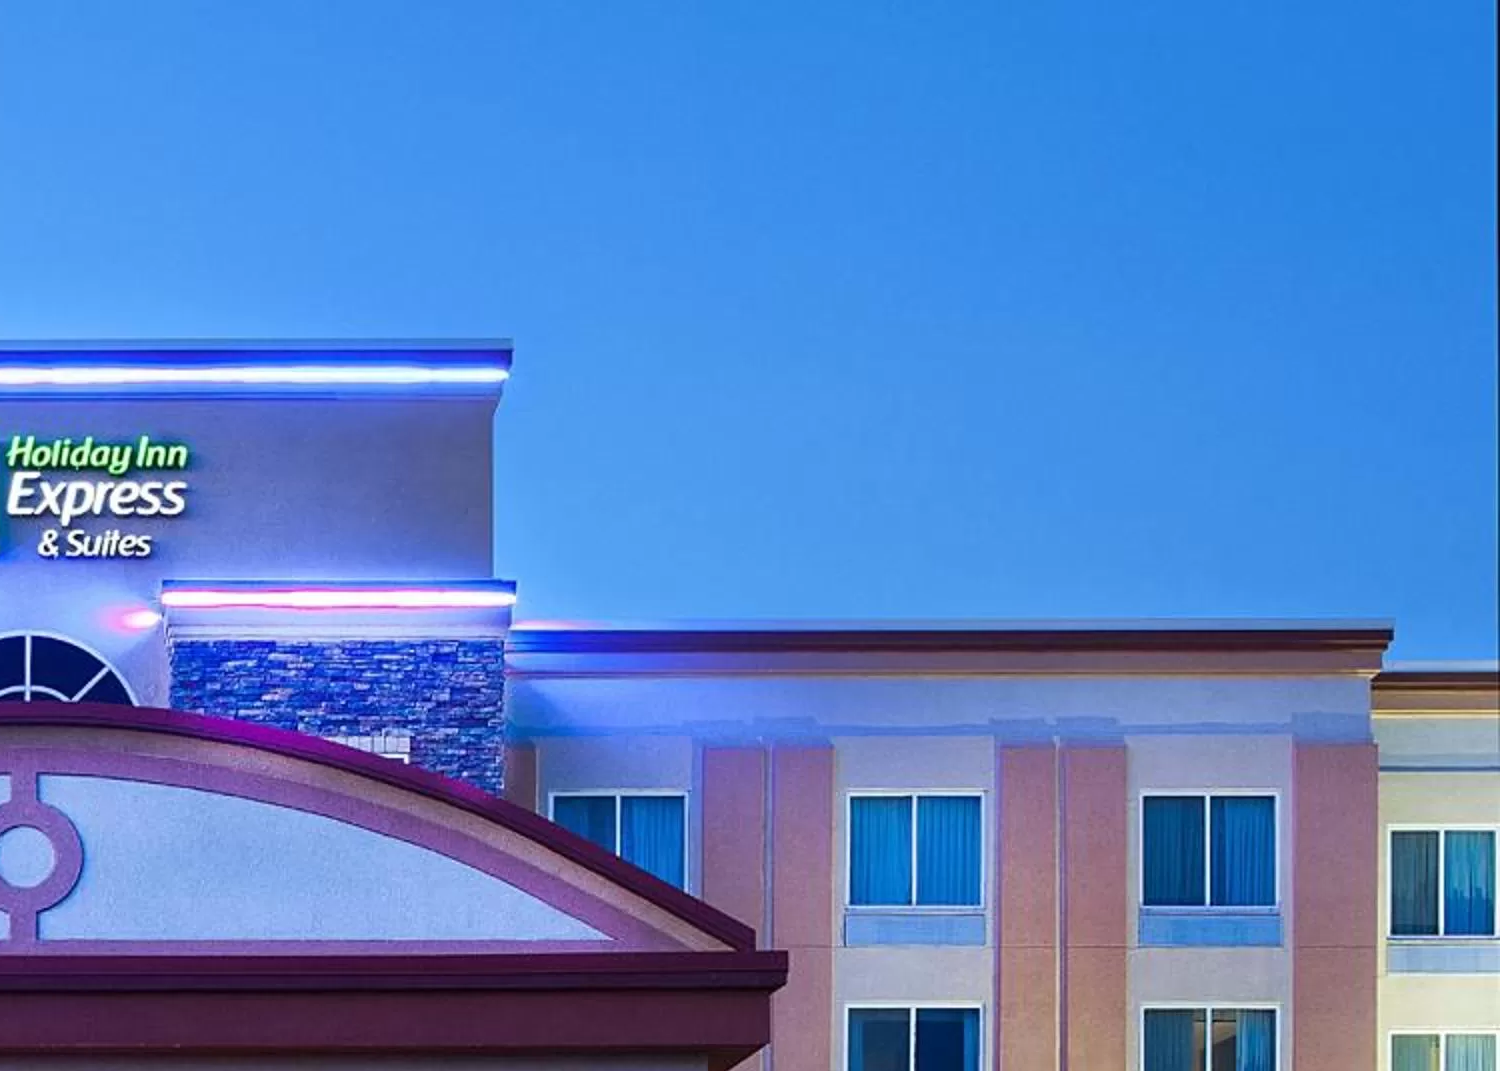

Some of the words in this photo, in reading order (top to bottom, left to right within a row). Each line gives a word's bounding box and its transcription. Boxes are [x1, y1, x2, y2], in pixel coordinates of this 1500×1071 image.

[7, 436, 131, 475] Holiday
[136, 436, 188, 468] Inn
[6, 471, 188, 526] Express
[38, 530, 59, 557] &
[65, 529, 152, 557] Suites
